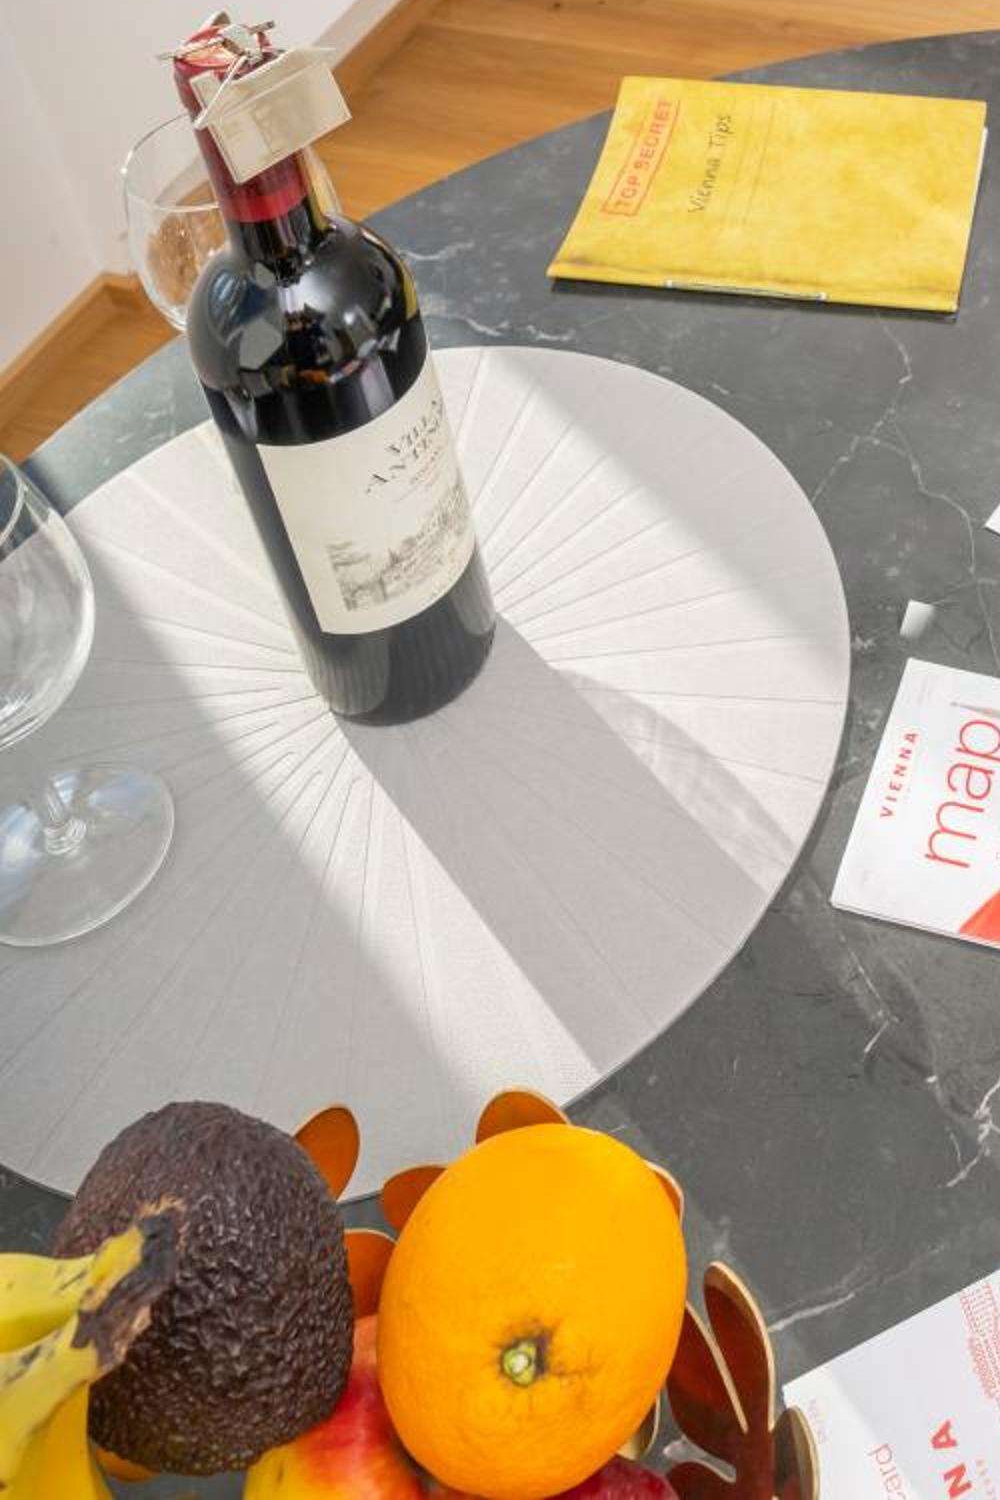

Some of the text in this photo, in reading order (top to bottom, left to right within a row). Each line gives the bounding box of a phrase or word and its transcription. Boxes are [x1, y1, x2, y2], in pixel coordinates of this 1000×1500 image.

[613, 100, 671, 208] TOP SECRET
[687, 114, 734, 213] Vienna Tips
[879, 732, 919, 819] VIENNA
